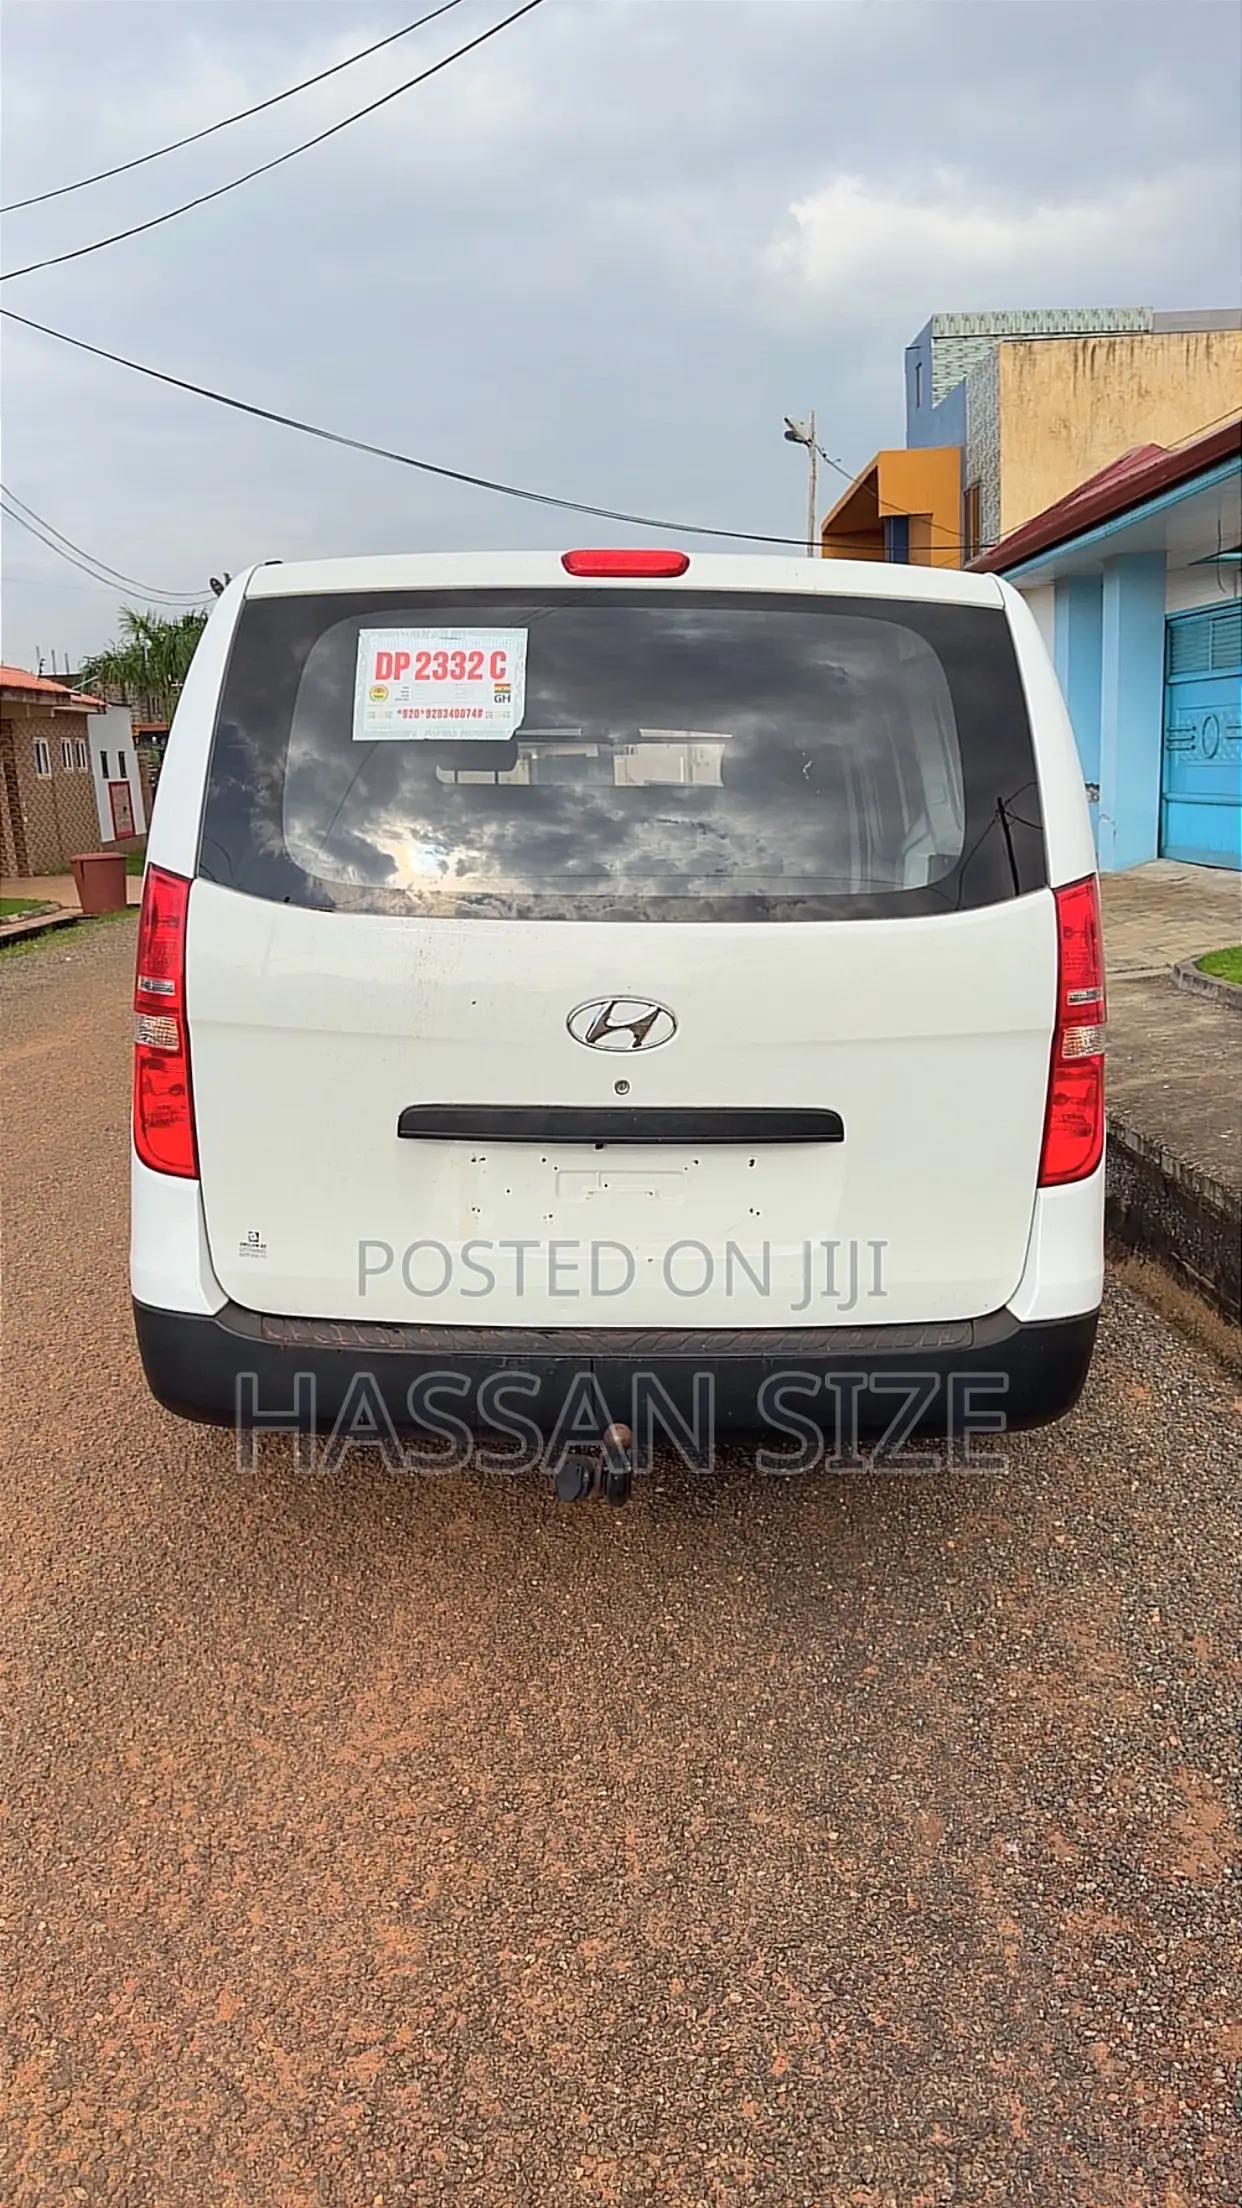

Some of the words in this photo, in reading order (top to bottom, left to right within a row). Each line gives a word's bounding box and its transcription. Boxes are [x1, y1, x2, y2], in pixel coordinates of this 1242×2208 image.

[375, 652, 411, 680] DP
[415, 651, 484, 680] 2332
[490, 651, 506, 680] C
[494, 694, 511, 703] GH
